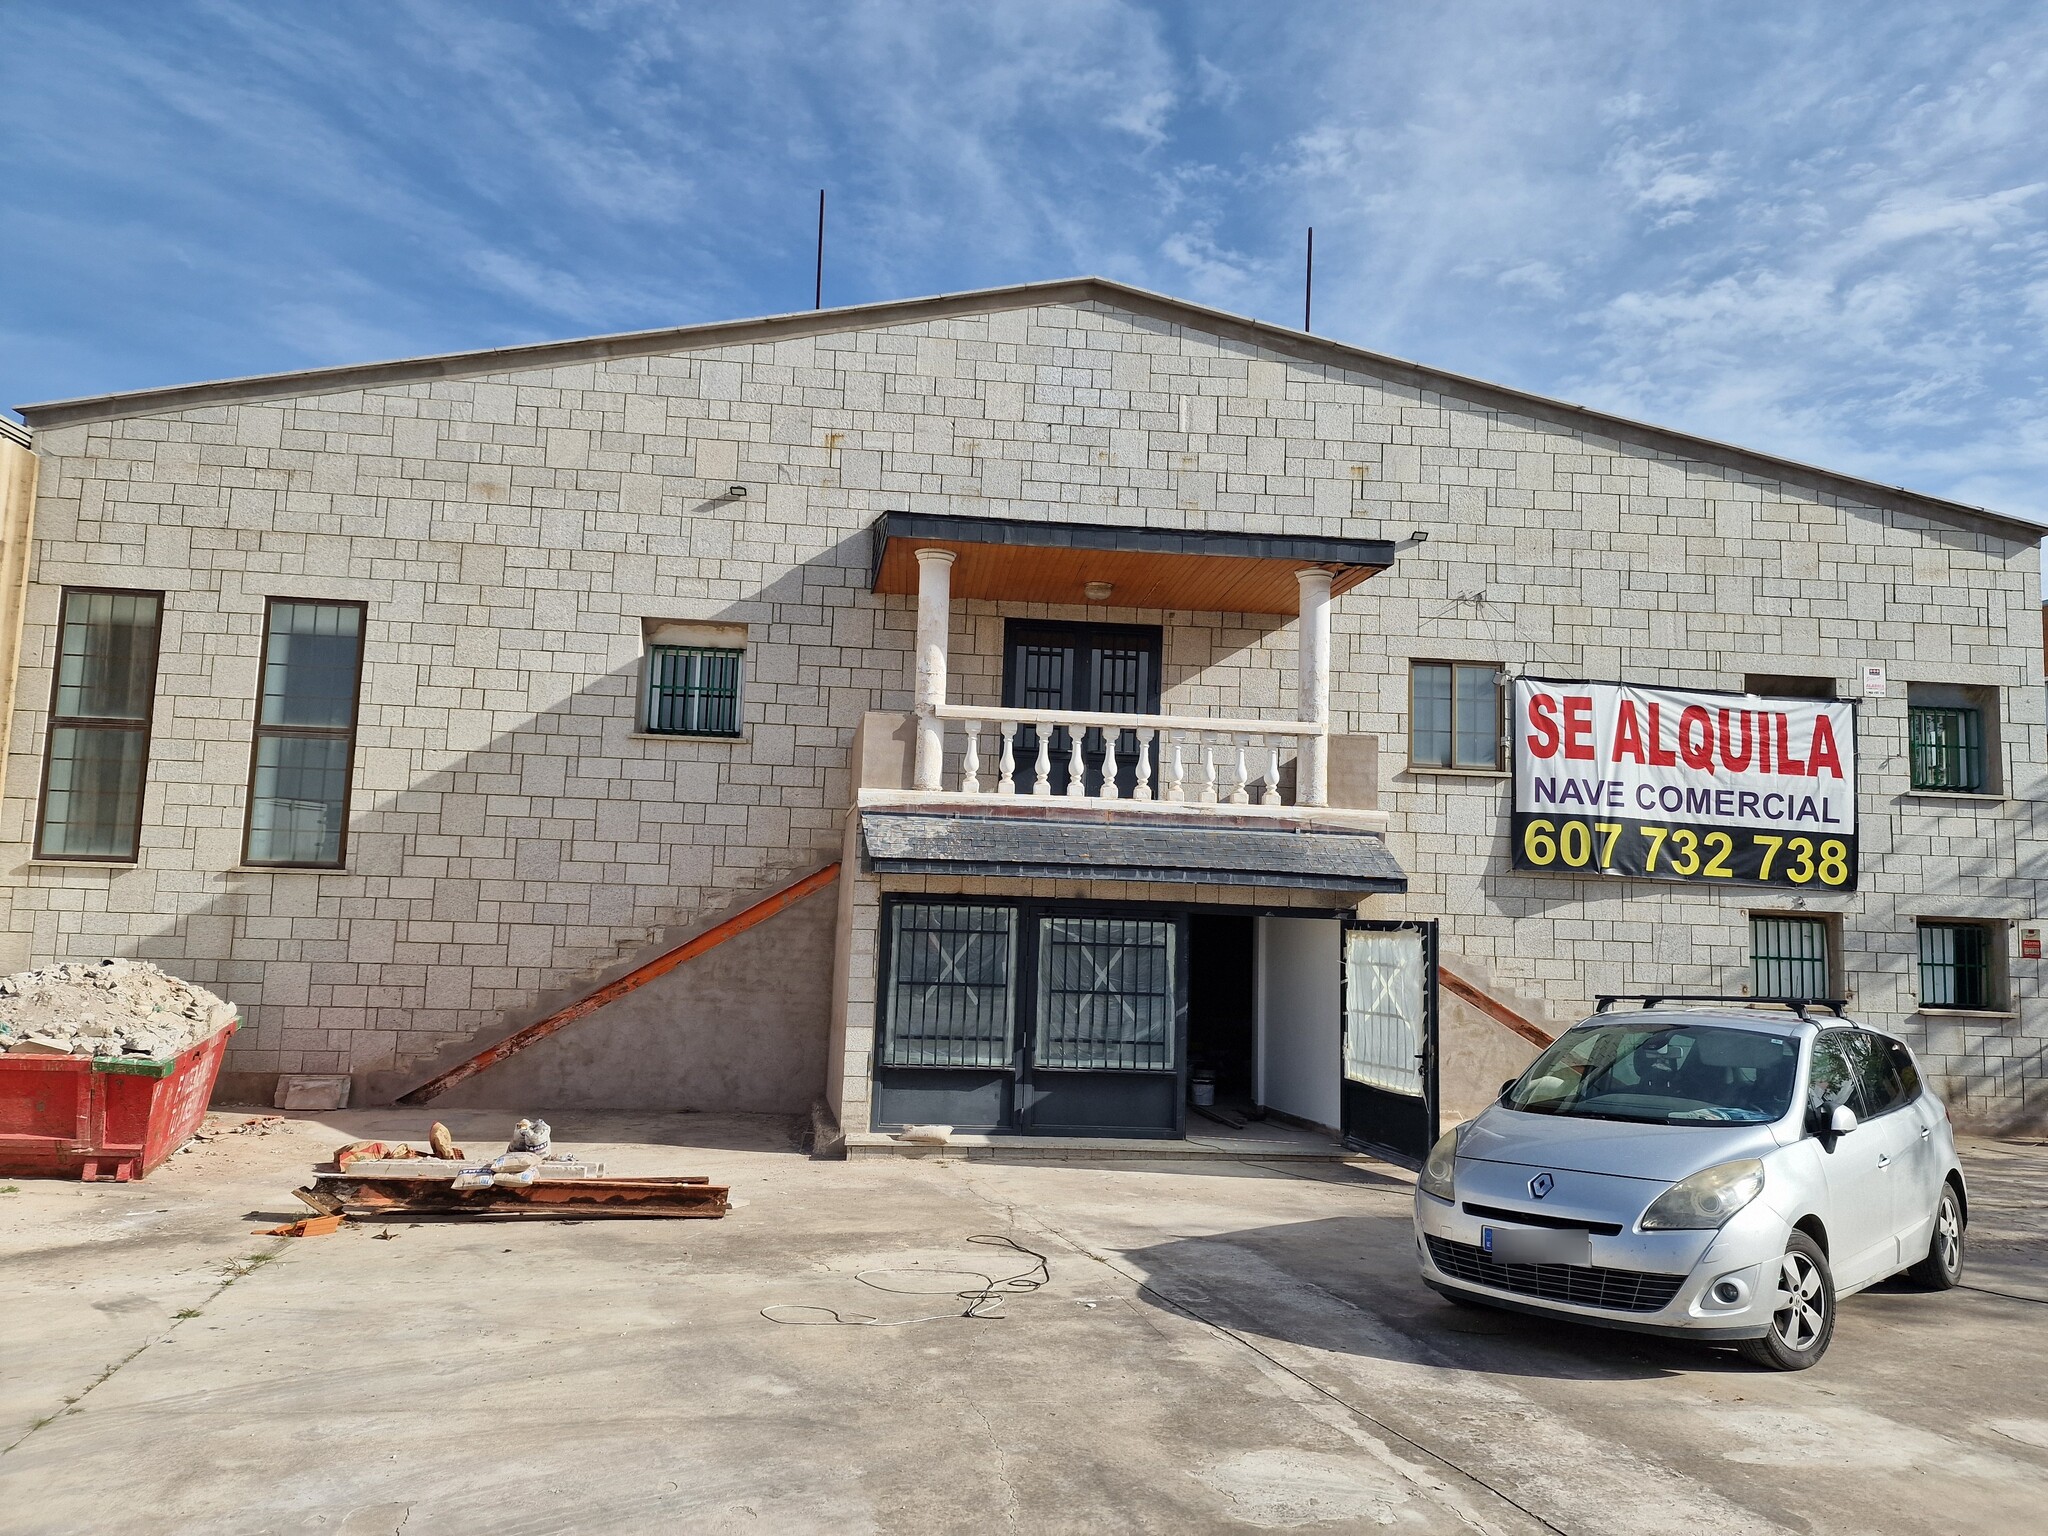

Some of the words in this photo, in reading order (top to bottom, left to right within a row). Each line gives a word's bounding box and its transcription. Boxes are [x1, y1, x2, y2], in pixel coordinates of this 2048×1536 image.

[1527, 693, 1595, 760] SE
[1612, 700, 1843, 778] ALQUILA
[1535, 777, 1624, 807] NAVE
[1636, 783, 1840, 824] COMERCIAL
[1524, 819, 1622, 868] 607
[1640, 826, 1733, 878] 732
[1753, 835, 1848, 885] 738
